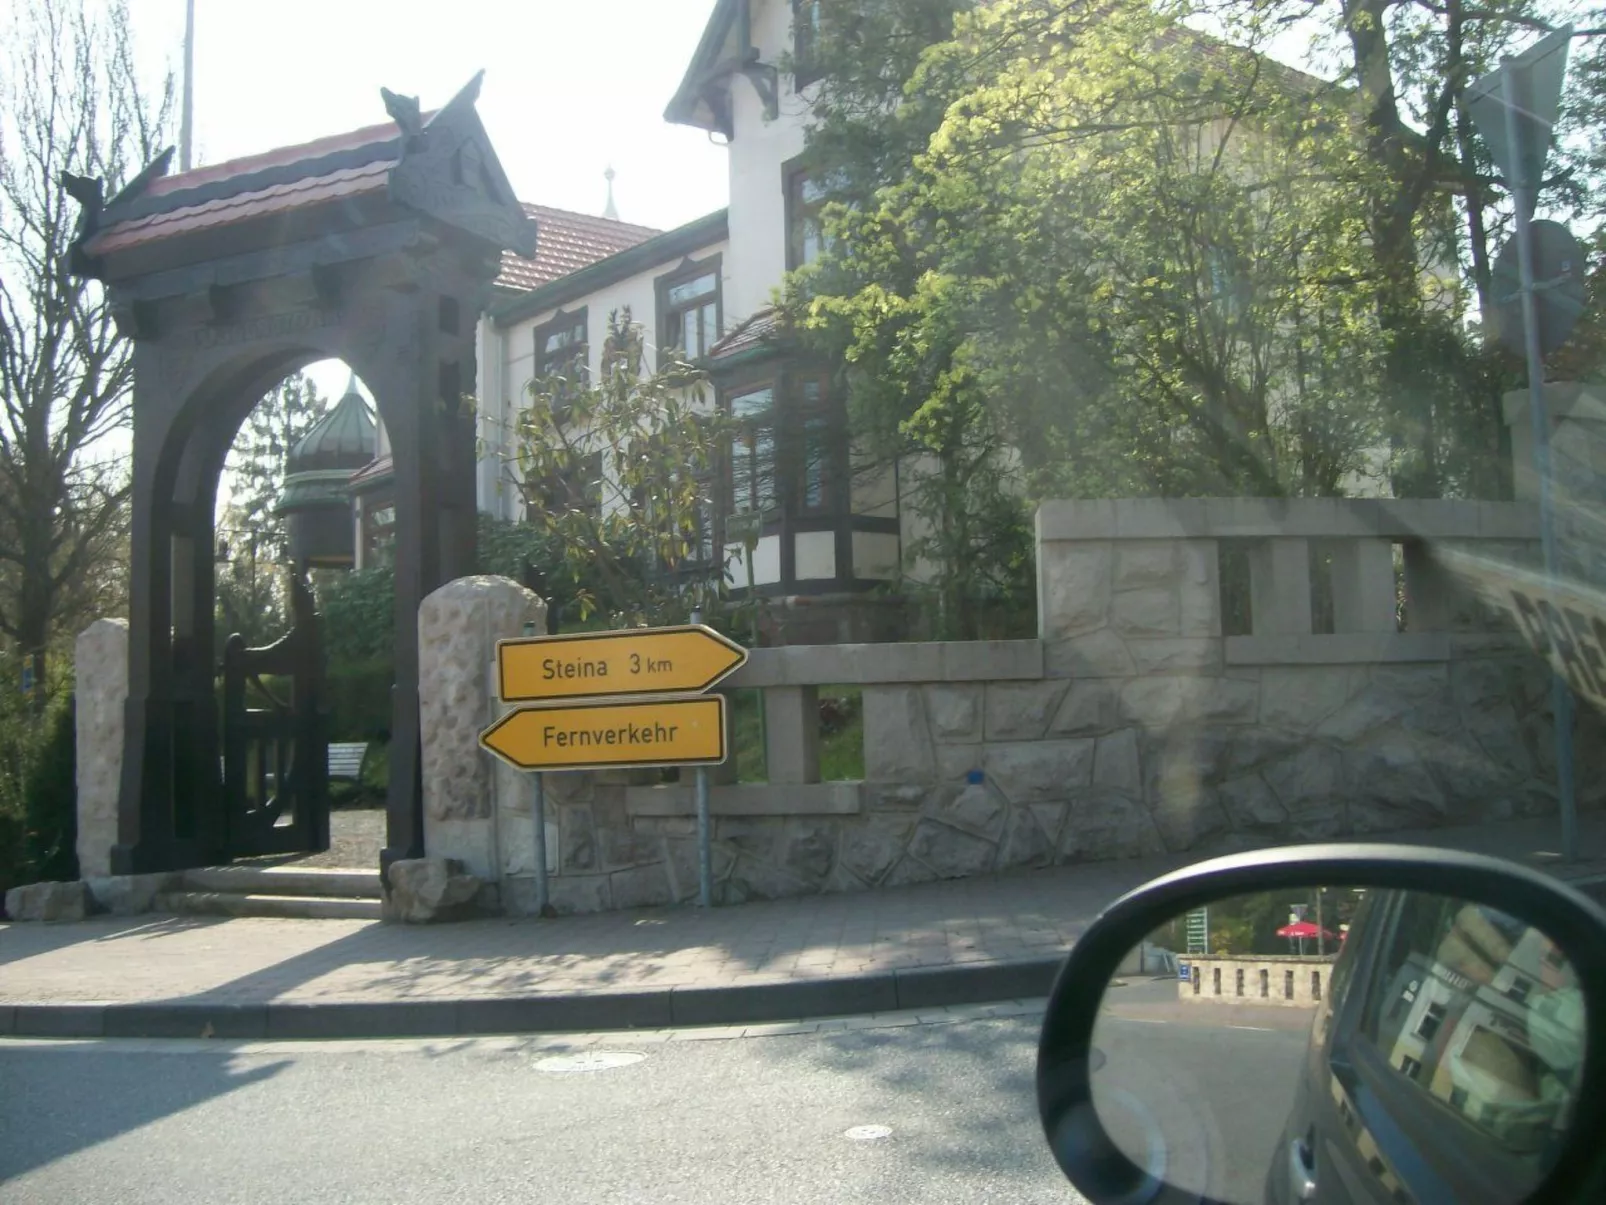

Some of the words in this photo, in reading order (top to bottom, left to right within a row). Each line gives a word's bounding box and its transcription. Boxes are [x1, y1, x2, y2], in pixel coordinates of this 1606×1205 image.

[542, 657, 608, 680] Steina
[629, 653, 641, 675] 3
[646, 657, 673, 673] km
[543, 722, 679, 748] Fernverkehr
